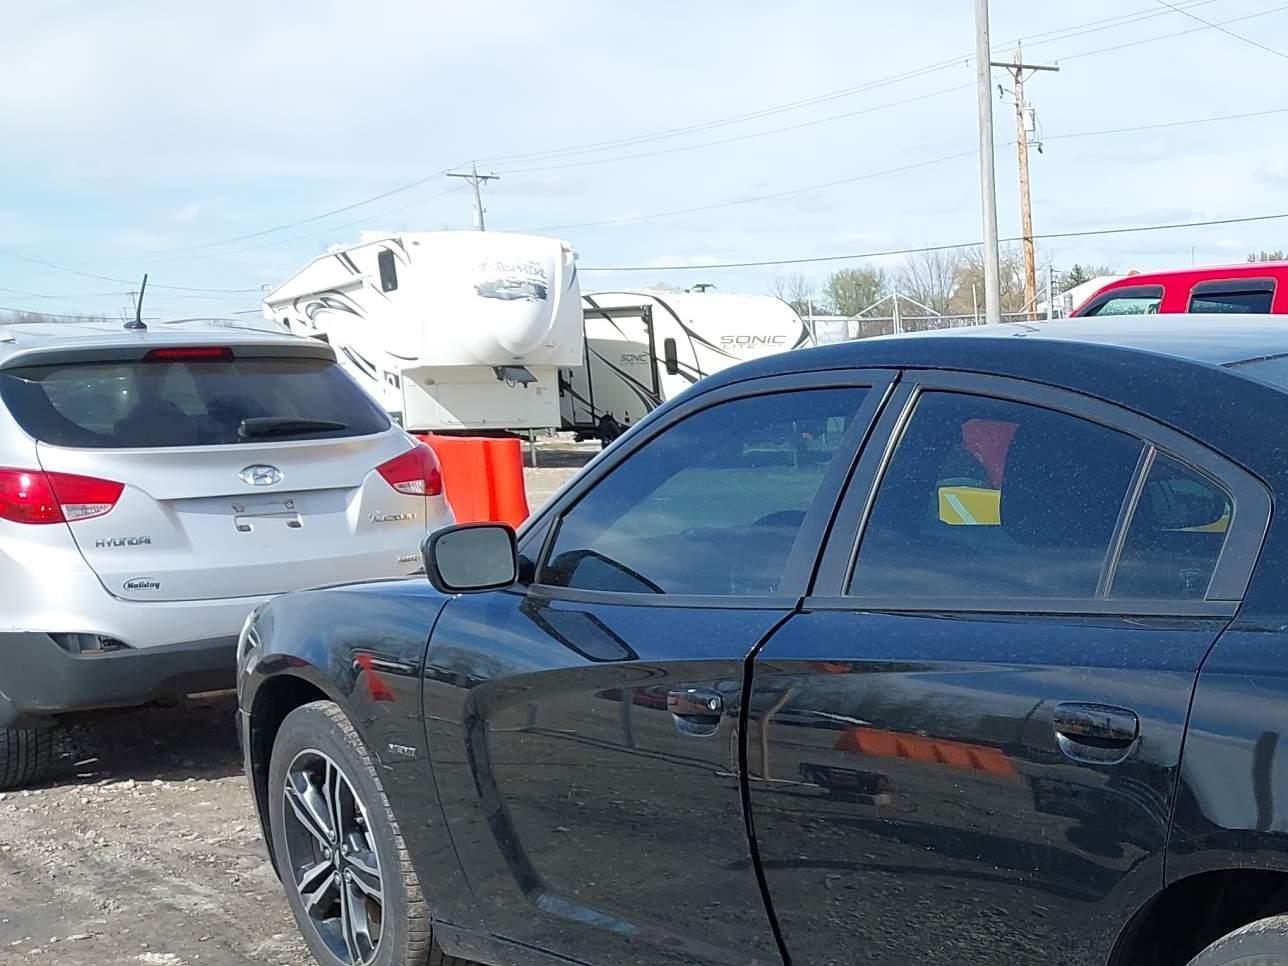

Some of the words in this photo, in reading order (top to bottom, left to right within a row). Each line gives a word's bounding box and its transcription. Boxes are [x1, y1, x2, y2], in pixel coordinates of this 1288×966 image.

[720, 335, 786, 344] SONIC
[620, 353, 647, 362] SONIC
[95, 536, 152, 548] HYUNDAI
[127, 581, 160, 590] Holiday
